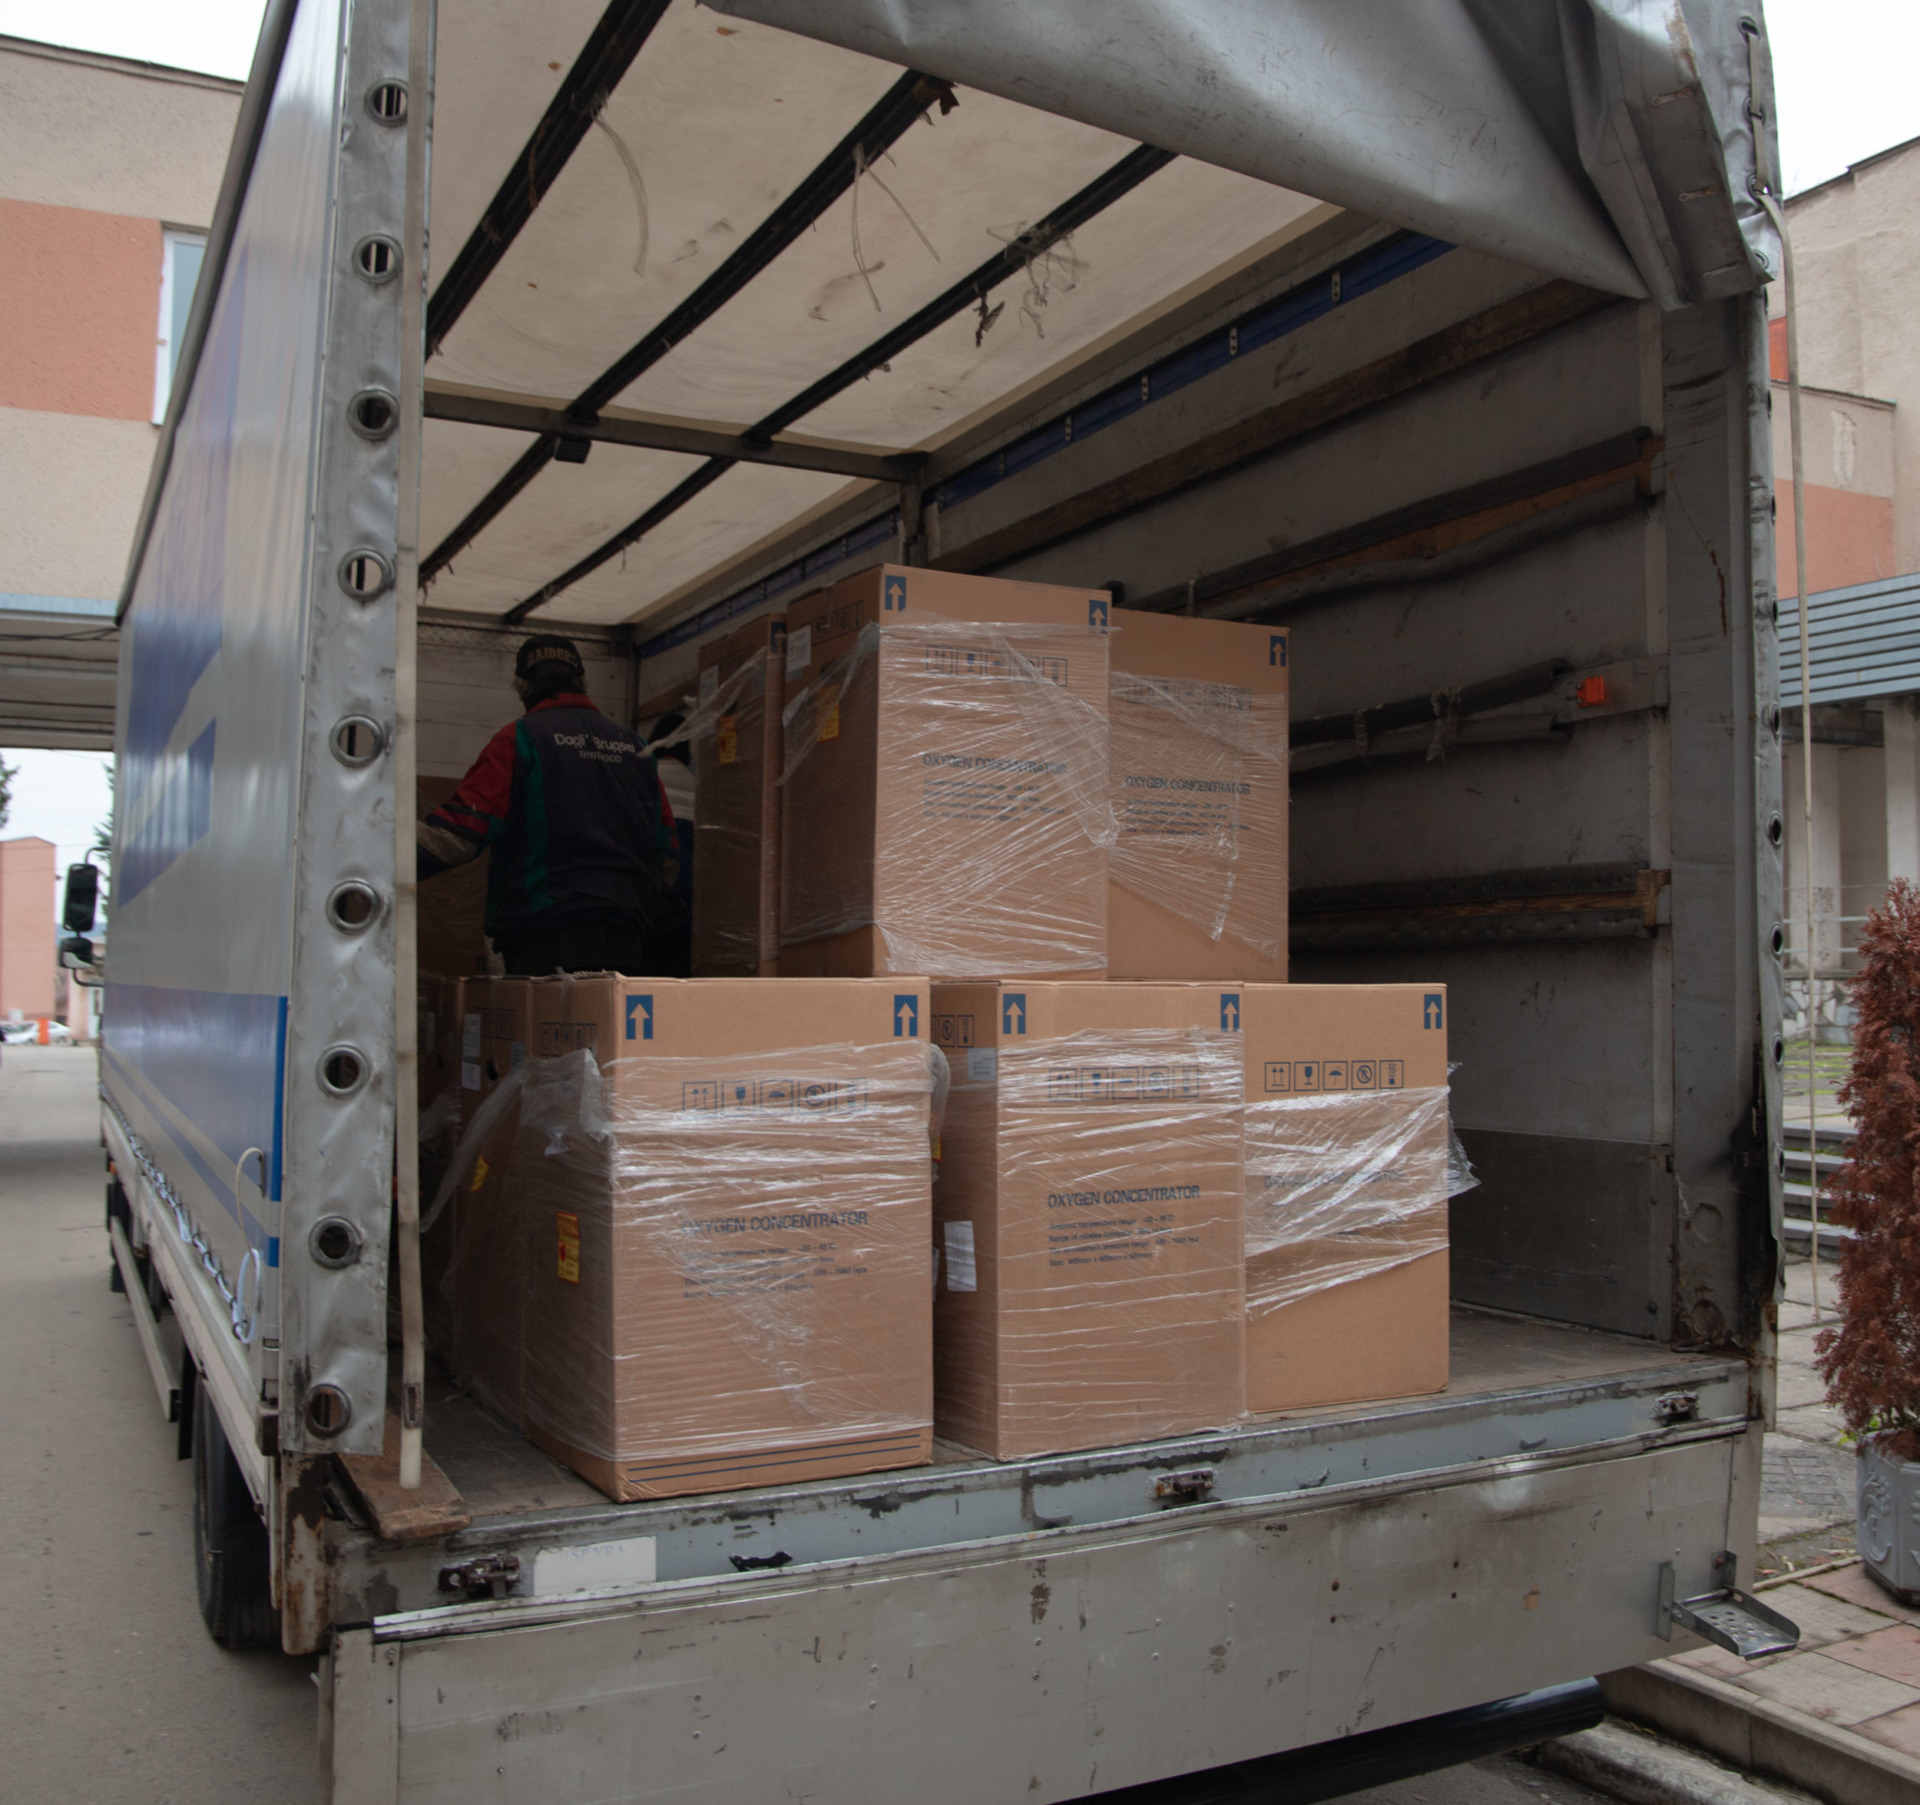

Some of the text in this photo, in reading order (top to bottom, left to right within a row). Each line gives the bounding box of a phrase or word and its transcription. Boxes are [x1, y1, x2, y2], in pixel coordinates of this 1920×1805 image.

[923, 754, 972, 769] OXYGEN
[1125, 776, 1251, 794] OXYGEN CONCENTRATOR
[1047, 1185, 1200, 1209] OXYGEN CONCENTRATOR
[681, 1210, 868, 1235] OXYGEN CONCENTRATOR
